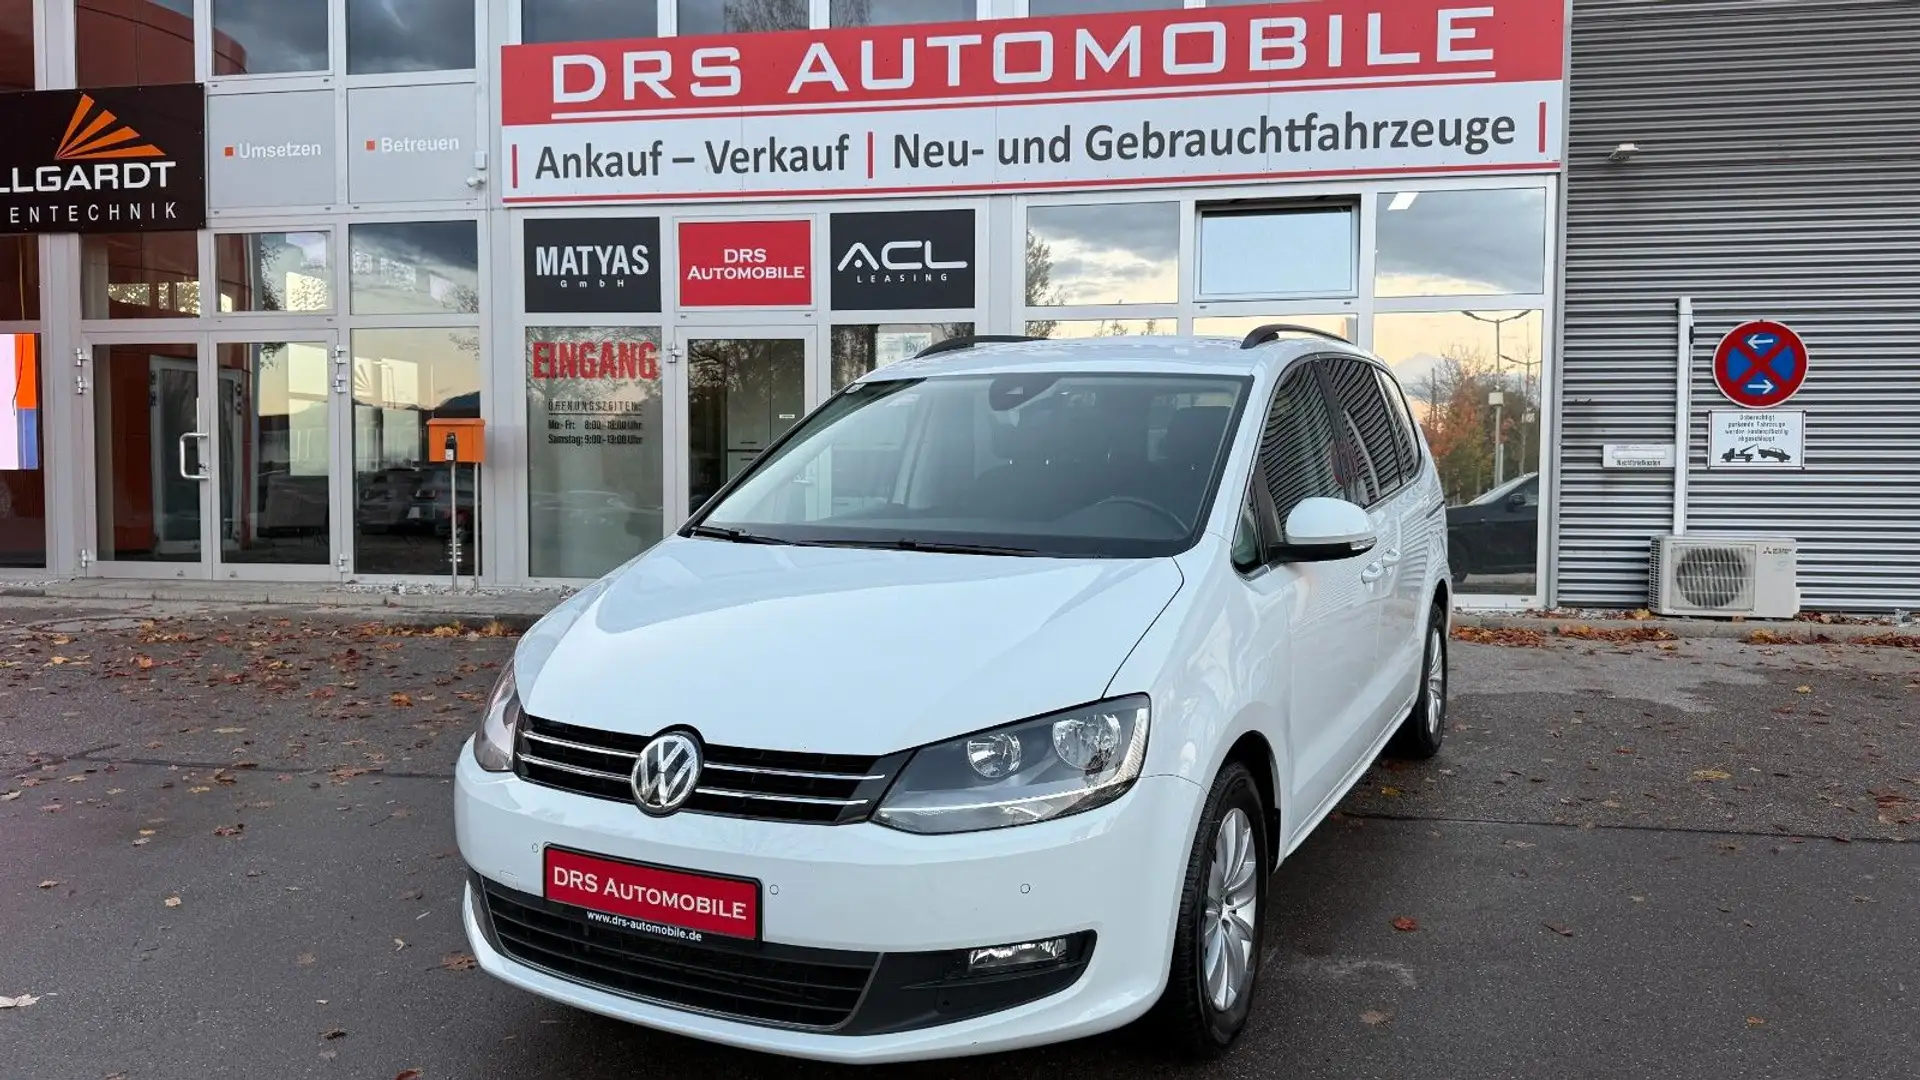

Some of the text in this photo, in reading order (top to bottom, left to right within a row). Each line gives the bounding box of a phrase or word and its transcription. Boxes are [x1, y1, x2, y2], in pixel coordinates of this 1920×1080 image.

[552, 6, 1495, 104] DRS AUTOMOBILE
[238, 141, 322, 159] Umsetzen
[381, 136, 459, 153] Betreuen
[535, 139, 663, 180] Ankauf
[704, 133, 850, 174] Verkauf
[893, 133, 984, 169] Neu-
[998, 125, 1072, 165] und
[1085, 112, 1516, 162] Gebrauchtfahrzeuge
[10, 201, 177, 224] ENTECHNIK
[536, 244, 650, 276] MATYAS
[723, 247, 768, 264] DRS
[837, 240, 968, 272] ACL
[559, 279, 625, 288] GmbH
[686, 265, 806, 280] AUTOMOBILE
[856, 273, 948, 284] LEASING
[532, 341, 658, 379] EINGANG
[554, 866, 747, 920] DRS AUTOMOBILE
[586, 910, 702, 942] www.drs-automobile.de
